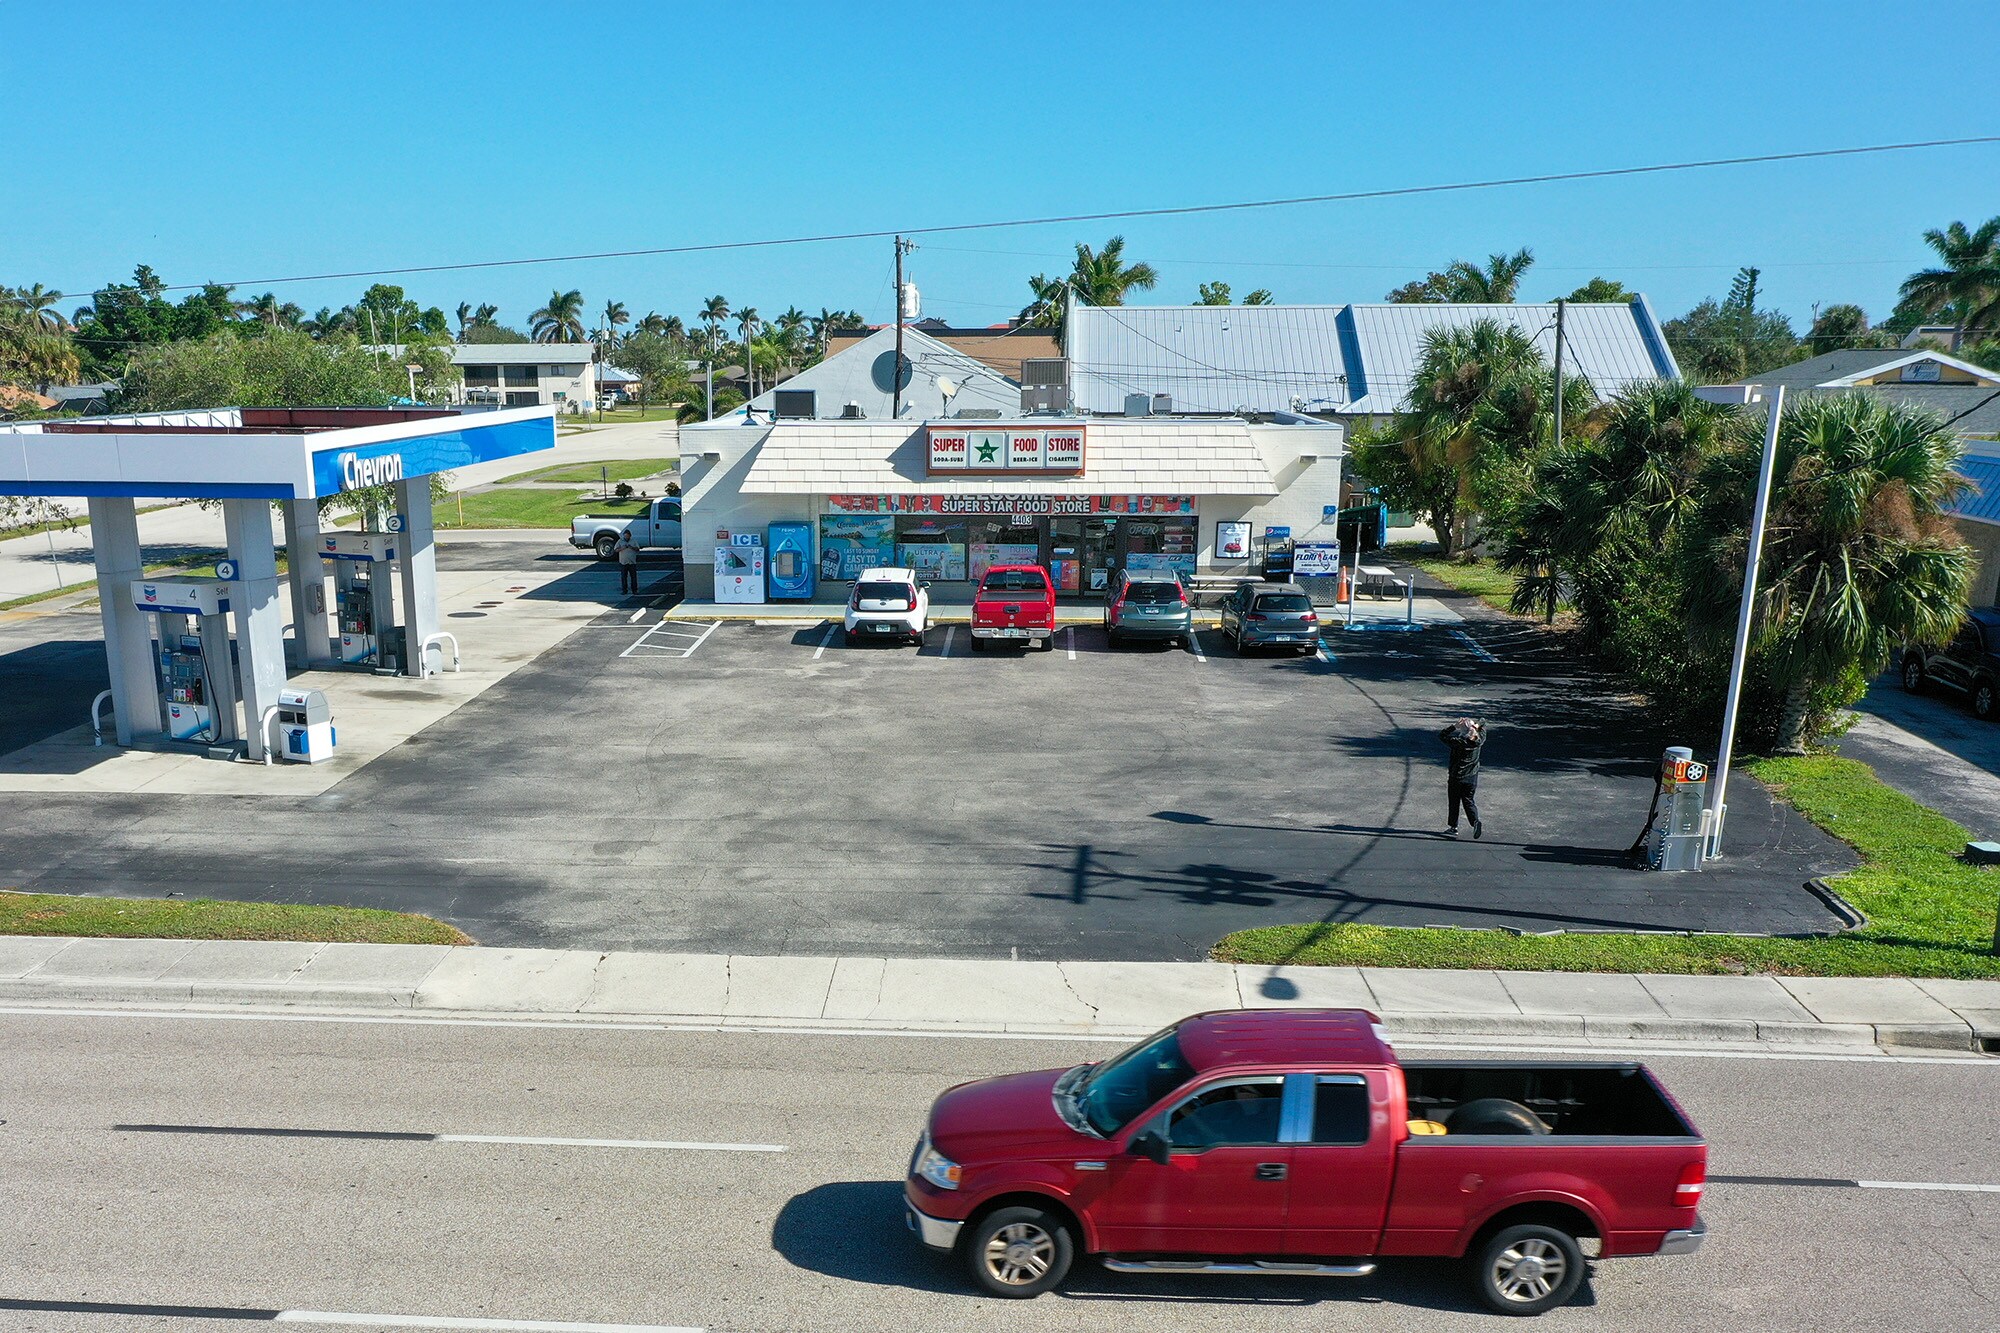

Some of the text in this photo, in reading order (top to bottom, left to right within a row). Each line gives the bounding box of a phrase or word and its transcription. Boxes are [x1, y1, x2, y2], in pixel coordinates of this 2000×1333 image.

[933, 438, 965, 452] SUPER
[1014, 438, 1038, 452] FOOD
[1048, 438, 1080, 452] STORE
[343, 452, 402, 490] Chevron
[942, 500, 1090, 513] SUPER STAR FOOD STORE
[1012, 515, 1032, 524] 4403
[986, 522, 1002, 533] EBT
[1129, 525, 1155, 535] OPEN
[733, 534, 759, 545] ICE
[363, 540, 368, 550] 2
[846, 555, 866, 564] EASY
[866, 555, 876, 564] TO
[221, 566, 230, 575] 4
[190, 588, 196, 600] 4
[216, 586, 229, 596] Self
